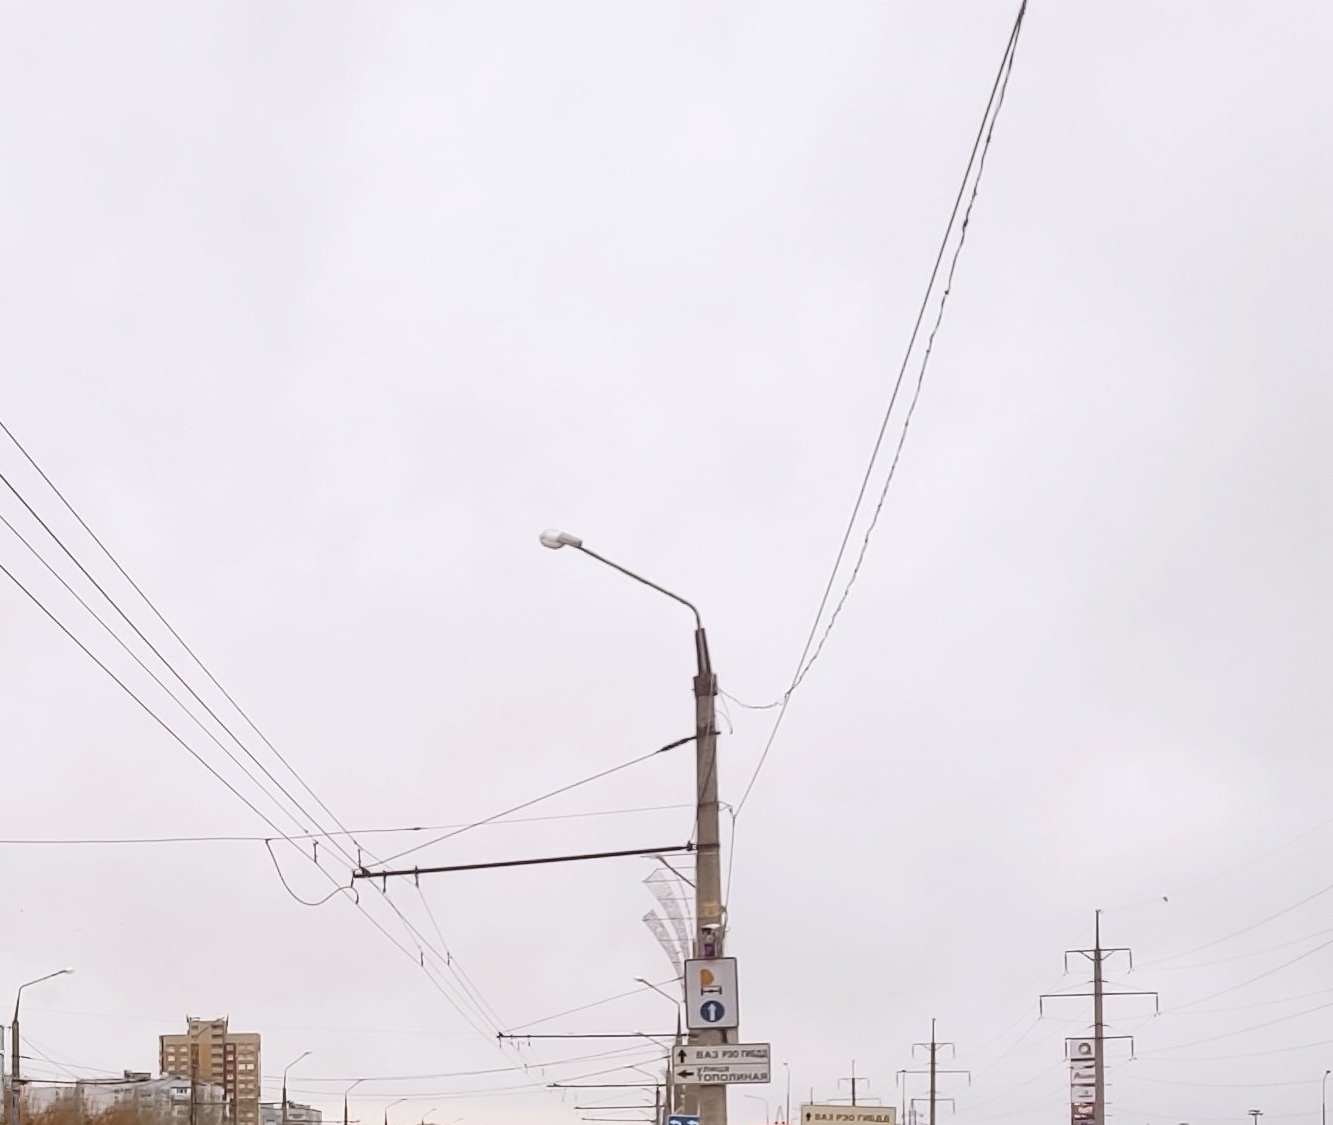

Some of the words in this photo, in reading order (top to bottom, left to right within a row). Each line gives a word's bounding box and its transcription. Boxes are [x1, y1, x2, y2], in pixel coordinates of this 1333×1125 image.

[696, 1050, 719, 1059] ВАЗ
[697, 1072, 768, 1082] ТОПОЛИНАЯ
[815, 1112, 834, 1121] ВАЗ
